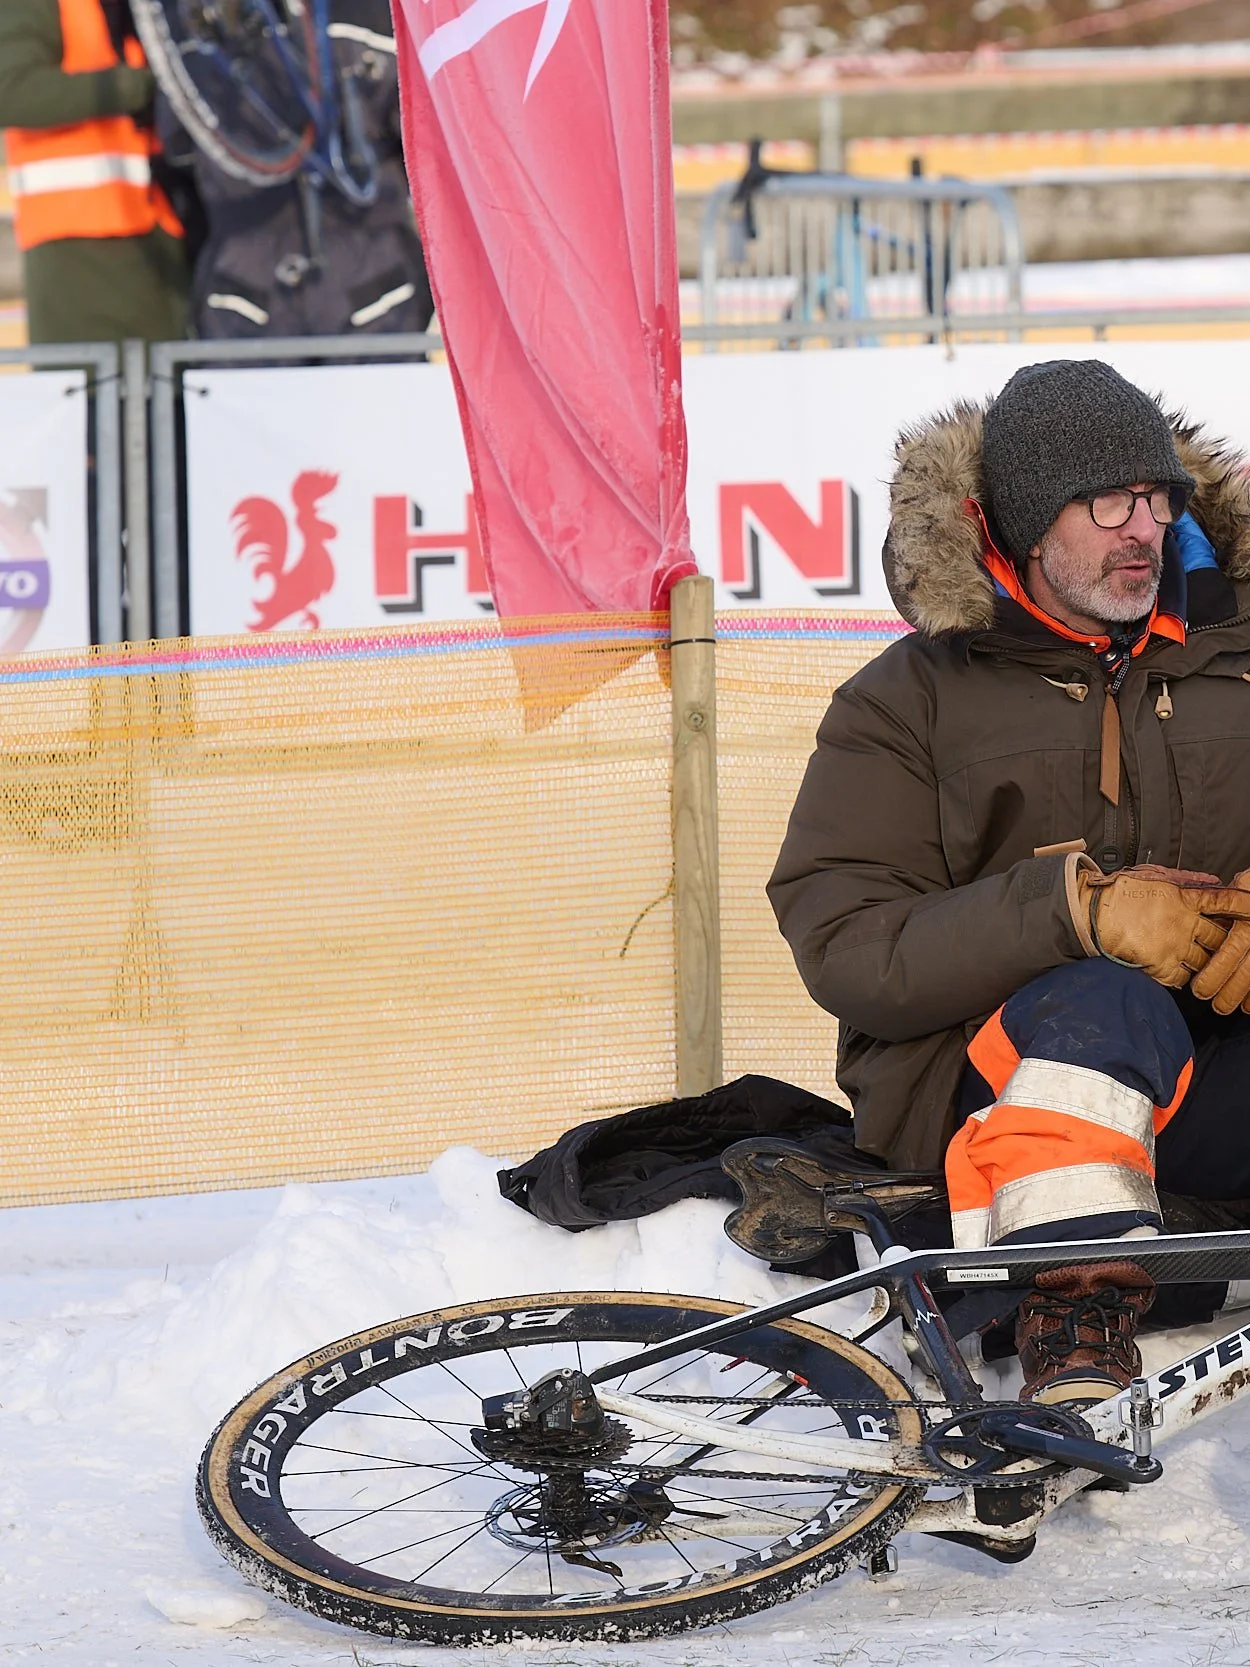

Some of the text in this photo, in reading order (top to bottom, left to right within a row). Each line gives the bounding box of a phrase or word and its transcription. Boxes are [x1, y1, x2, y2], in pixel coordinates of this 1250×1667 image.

[1122, 890, 1167, 899] HESTRA
[240, 1308, 574, 1499] BONTRAGER
[550, 1414, 889, 1604] BOTRAR
